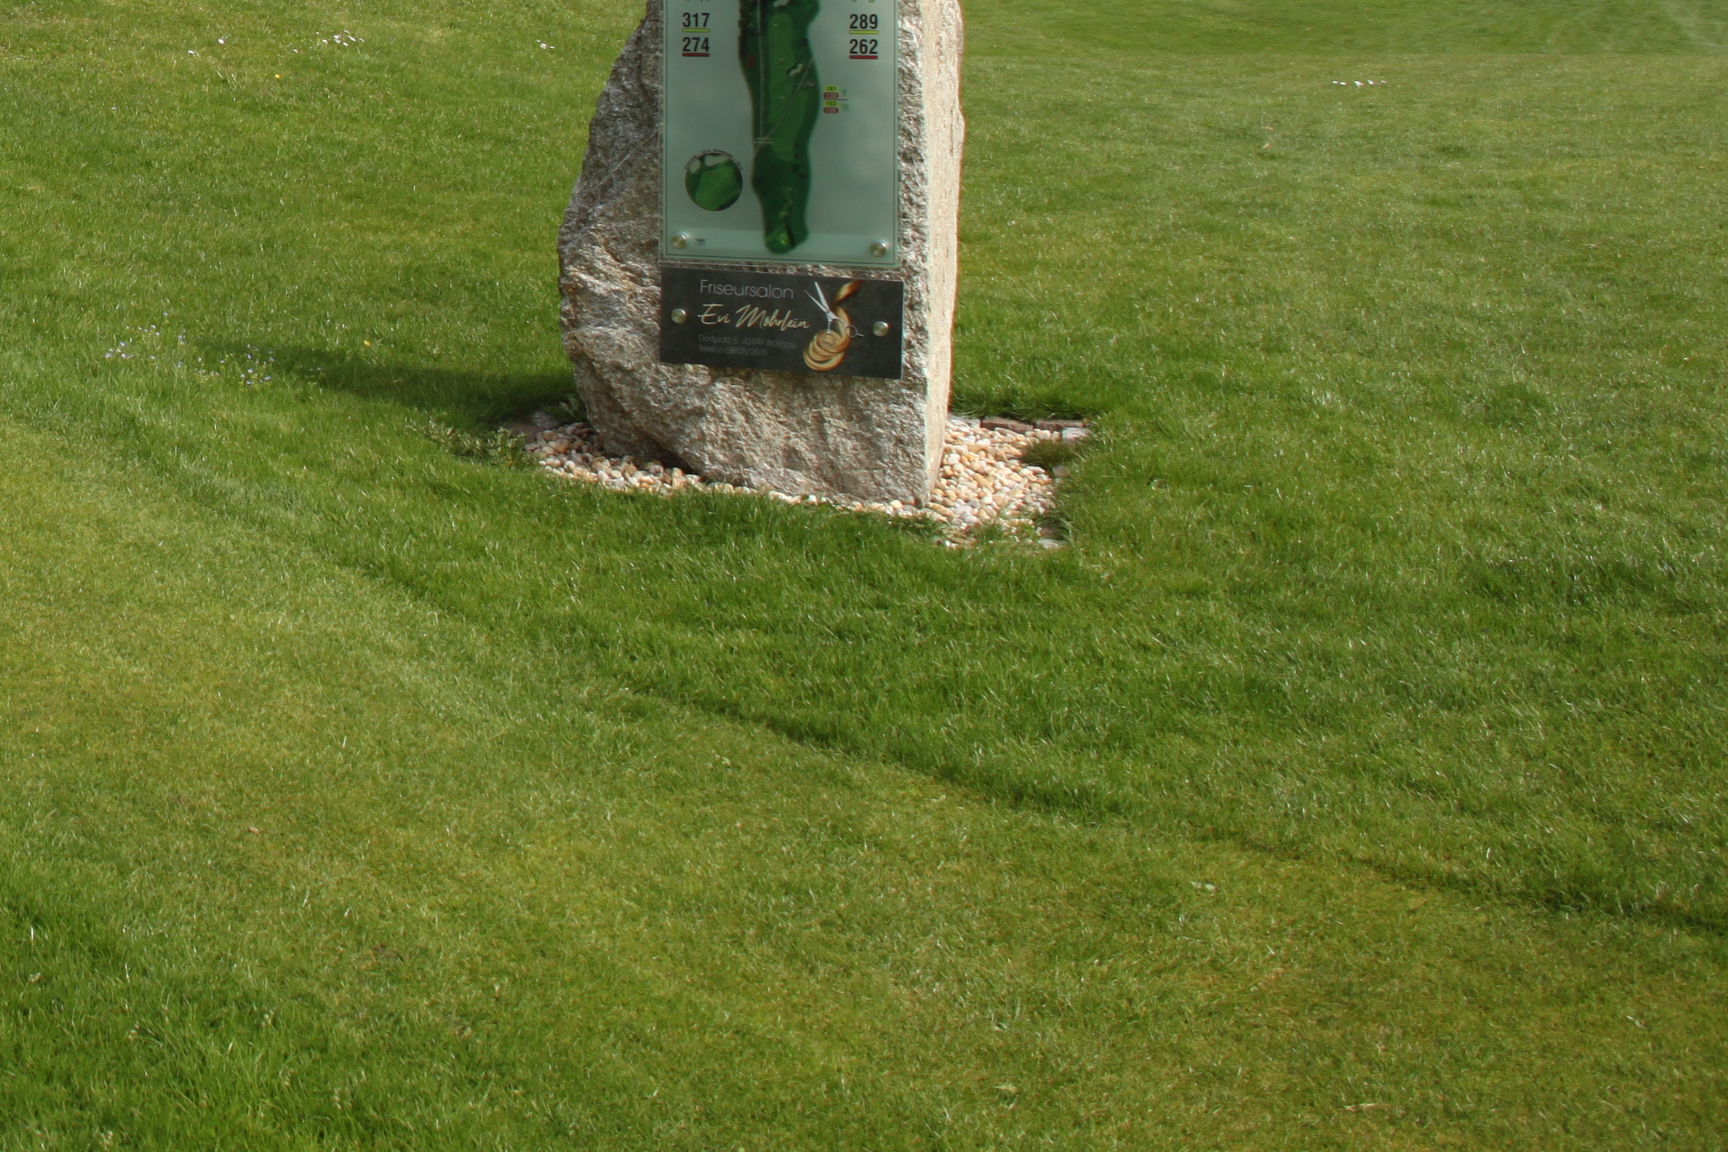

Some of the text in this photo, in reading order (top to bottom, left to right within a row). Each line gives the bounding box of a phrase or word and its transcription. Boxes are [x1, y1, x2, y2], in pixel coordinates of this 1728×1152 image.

[682, 12, 710, 28] 317
[849, 13, 878, 30] 289
[682, 37, 710, 52] 274
[849, 38, 878, 54] 262
[699, 279, 794, 299] Friseursalon
[697, 302, 731, 326] Evi
